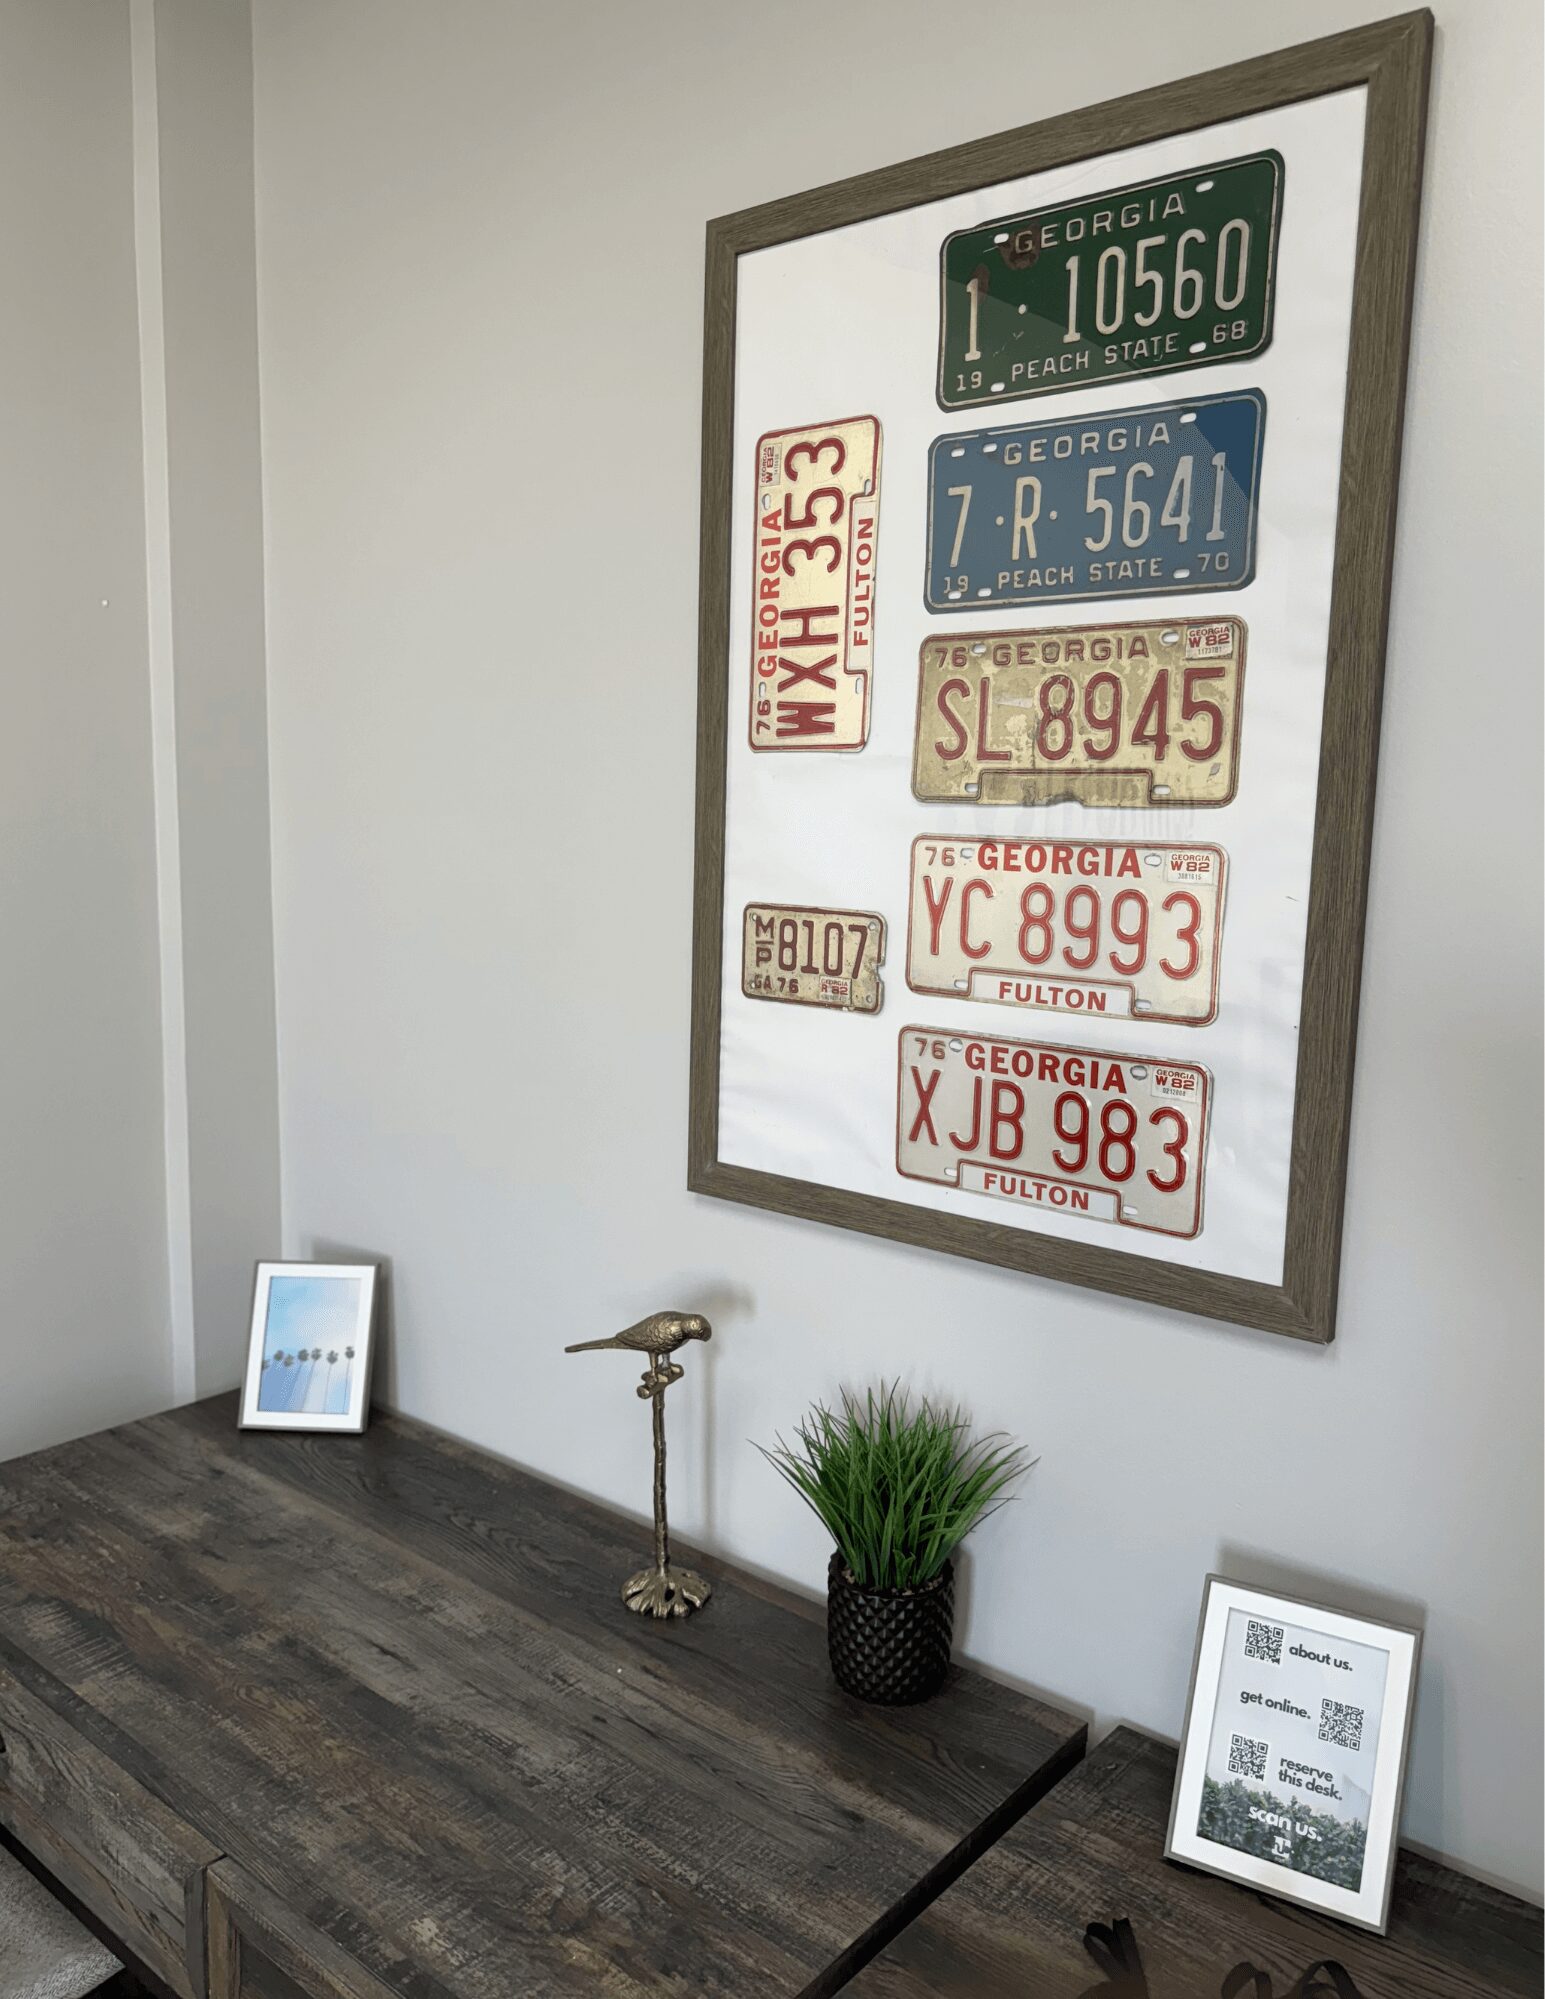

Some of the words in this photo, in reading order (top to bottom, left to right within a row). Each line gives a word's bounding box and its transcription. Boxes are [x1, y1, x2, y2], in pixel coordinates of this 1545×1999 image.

[1015, 193, 1184, 255] GEORGIA
[1063, 218, 1250, 343] 10560
[1212, 320, 1246, 344] 68
[1011, 351, 1090, 382] PEACH
[1105, 333, 1179, 362] STATE
[956, 371, 982, 392] 19
[1004, 422, 1170, 465] GEORGIA
[782, 437, 846, 577] 353
[1084, 452, 1226, 552] 5641
[998, 566, 1074, 590] PEACH
[1089, 558, 1162, 582] STATE
[1197, 552, 1229, 572] 70
[758, 508, 782, 678] GEORGIA
[853, 518, 874, 646] FULTON
[943, 575, 969, 594] 19
[1189, 626, 1230, 637] GEORGIA
[1189, 636, 1201, 648] W
[1205, 633, 1230, 646] 82
[935, 647, 968, 667] 76
[992, 636, 1149, 666] GEORGIA
[776, 605, 839, 737] WXH
[756, 699, 771, 735] 76
[935, 677, 1012, 761] SL
[1037, 667, 1225, 761] 8945
[925, 847, 955, 866] 76
[977, 843, 1141, 878] GEORGIA
[1171, 861, 1183, 871] W
[1186, 861, 1210, 872] 82
[755, 916, 774, 938] M
[923, 876, 994, 959] YC
[1018, 882, 1201, 980] 8993
[756, 946, 772, 967] P
[778, 918, 868, 980] 8107
[754, 974, 772, 990] GA
[777, 977, 799, 994] 76
[999, 981, 1106, 1011] FULTON
[914, 1037, 946, 1060] 76
[965, 1043, 1127, 1094] GEORGIA
[1155, 1075, 1168, 1086] W
[1171, 1078, 1195, 1090] 82
[1156, 1069, 1195, 1080] GEORGIA
[909, 1066, 1025, 1161] XJB
[1052, 1091, 1189, 1192] 983
[984, 1172, 1089, 1210] FULTON
[1289, 1643, 1331, 1666] about
[1333, 1654, 1353, 1672] us.
[1240, 1690, 1263, 1707] get
[1265, 1695, 1311, 1720] online.
[1278, 1768, 1303, 1788] this
[1305, 1777, 1343, 1801] desk.
[1280, 1757, 1333, 1783] reserve
[1248, 1806, 1292, 1831] scan
[1295, 1821, 1323, 1842] us.
